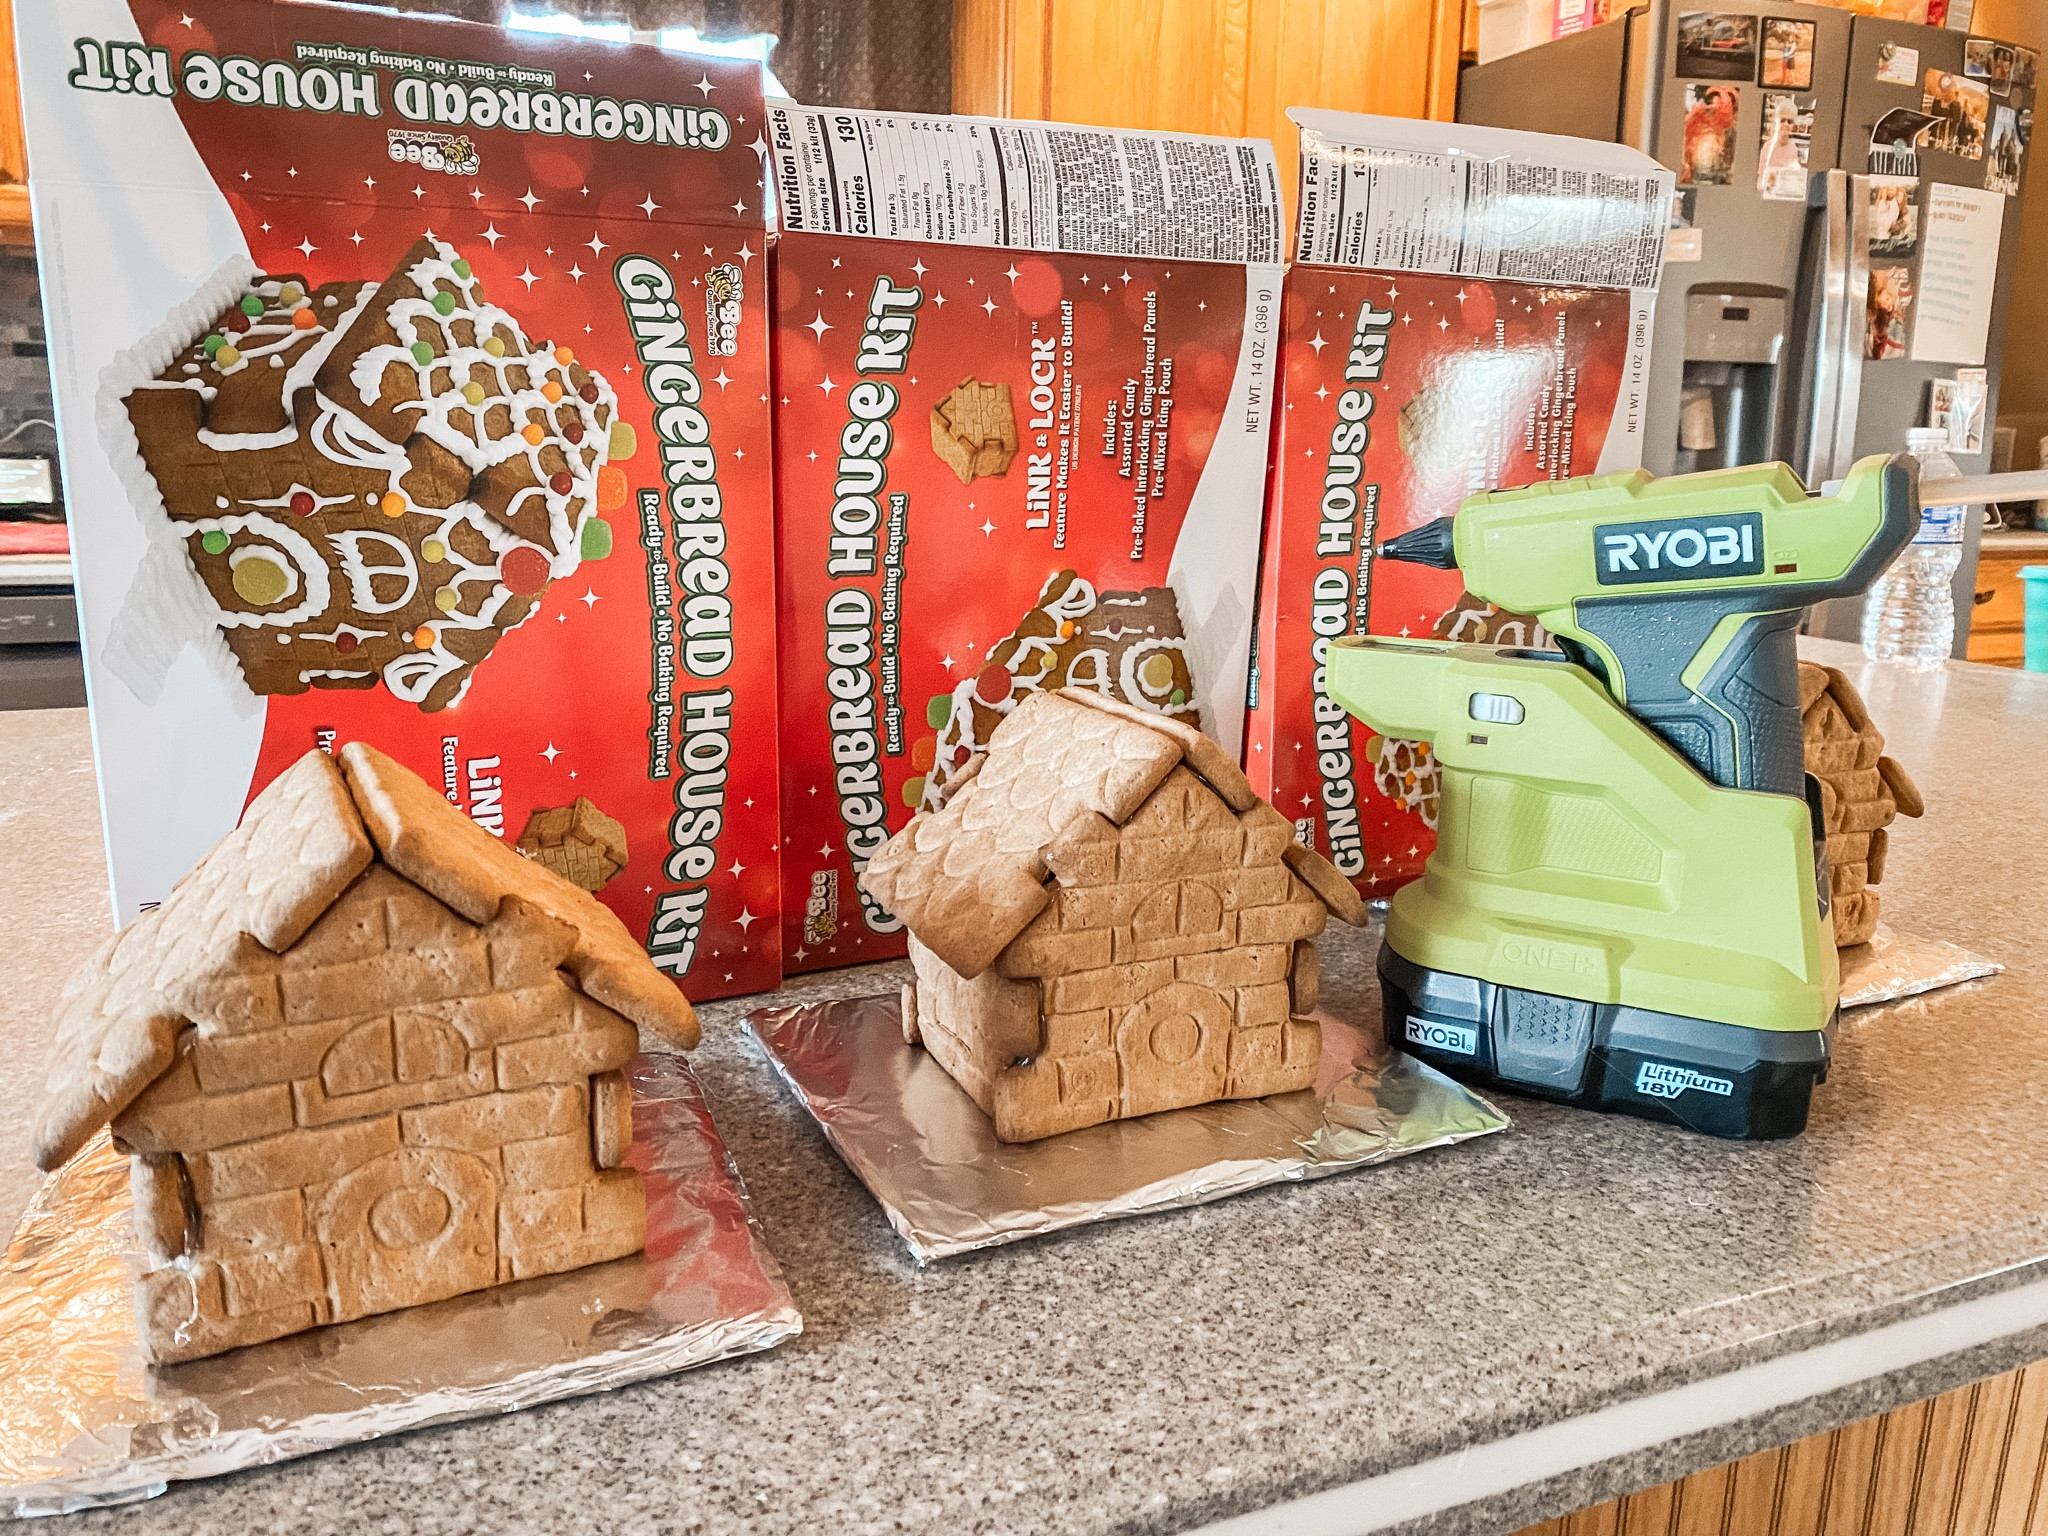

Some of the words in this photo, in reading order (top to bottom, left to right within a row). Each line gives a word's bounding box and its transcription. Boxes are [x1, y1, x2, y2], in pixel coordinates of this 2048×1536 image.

[297, 45, 366, 65] Required
[370, 51, 423, 71] Baking
[426, 60, 446, 74] No
[389, 130, 405, 138] 1970
[407, 133, 425, 141] Since
[428, 133, 452, 142] Quality
[772, 110, 792, 150] Facts
[805, 116, 818, 134] (33g)
[835, 116, 856, 142] 130
[809, 136, 819, 146] kit
[390, 144, 445, 169] Bee
[800, 142, 812, 173] container
[812, 148, 822, 164] 1/12
[975, 150, 984, 169] Sugars
[781, 156, 803, 229] Nutrition
[806, 174, 816, 186] per
[818, 177, 827, 194] size
[977, 170, 986, 188] Added
[807, 188, 818, 219] servings
[852, 175, 868, 234] Calories
[945, 172, 954, 219] Carbohydrate
[970, 197, 978, 218] Sugars
[811, 220, 819, 229] 12
[820, 197, 831, 231] Serving
[900, 200, 909, 229] Saturated
[923, 197, 933, 239] Cholesterol
[959, 212, 967, 234] Dietary
[1299, 191, 1317, 262] Nutrition
[947, 222, 955, 241] Total
[1318, 223, 1327, 252] servings
[1349, 211, 1363, 264] Calories
[1325, 233, 1335, 263] Serving
[1257, 289, 1272, 302] g)
[1061, 300, 1074, 347] Build!
[1143, 291, 1156, 333] Panels
[1254, 305, 1270, 333] (396
[1637, 310, 1648, 321] g)
[719, 300, 740, 355] Bee
[1556, 311, 1566, 346] Panels
[1635, 324, 1646, 348] (396
[1061, 350, 1073, 367] to
[1252, 338, 1266, 358] OZ.
[1139, 337, 1156, 416] Gingerbread
[1157, 358, 1173, 395] Pouch
[1251, 363, 1263, 376] 14
[1551, 350, 1565, 417] Gingerbread
[1566, 367, 1577, 399] Pouch
[1632, 373, 1641, 384] 14
[1059, 370, 1073, 420] Easier
[1121, 378, 1139, 417] Candy
[1248, 382, 1262, 405] WT.
[1539, 384, 1552, 418] Candy
[1630, 389, 1640, 409] WT.
[1073, 412, 1081, 436] PATENT
[1102, 399, 1117, 455] Includes:
[1156, 399, 1173, 428] Icing
[1246, 408, 1259, 433] NET
[1524, 403, 1537, 451] Includes:
[1563, 402, 1576, 428] Icing
[1627, 412, 1638, 433] NET
[1036, 434, 1047, 448] &
[1058, 422, 1071, 435] It
[1072, 437, 1080, 460] DESIGN
[1118, 421, 1133, 477] Assorted
[1134, 420, 1153, 492] Interlocking
[1536, 421, 1549, 469] Assorted
[1550, 420, 1563, 480] nterlocking
[1561, 431, 1573, 480] re-Mixed
[1056, 439, 1070, 489] Makes
[1152, 432, 1167, 497] Pre-Mixed
[884, 496, 904, 565] Required
[1053, 492, 1068, 548] Feature
[1130, 497, 1146, 559] Pre-Baked
[1360, 486, 1377, 546] Required
[1604, 524, 1753, 572] RYOBI
[1357, 549, 1372, 596] Baking
[882, 568, 900, 620] Baking
[1357, 598, 1367, 616] No
[657, 620, 671, 642] No
[882, 624, 896, 644] No
[654, 646, 673, 702] Baking
[652, 706, 673, 777] Required
[442, 737, 459, 800] Feature
[808, 873, 827, 916] Bee
[1408, 1021, 1466, 1049] RYOBI
[1641, 1081, 1680, 1096] 18V
[1644, 1065, 1729, 1092] Lithium
